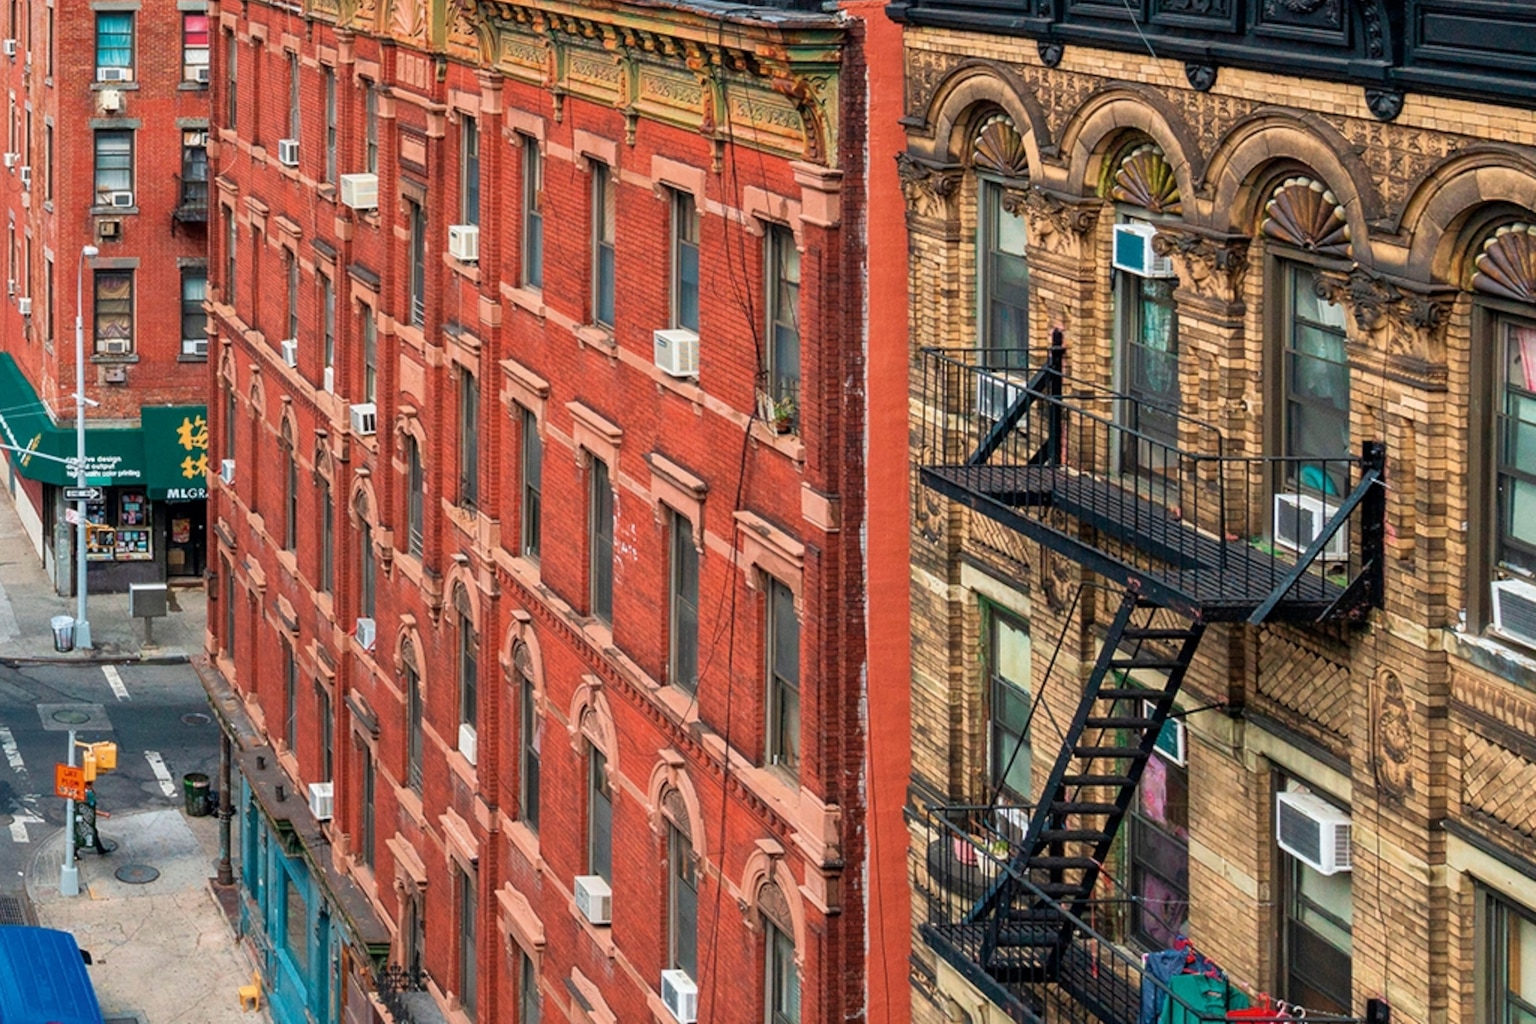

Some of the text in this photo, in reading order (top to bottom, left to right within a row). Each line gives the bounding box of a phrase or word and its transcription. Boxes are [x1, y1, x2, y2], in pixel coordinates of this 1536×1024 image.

[96, 456, 122, 465] design
[117, 469, 141, 478] printing
[167, 488, 208, 499] MLGR
